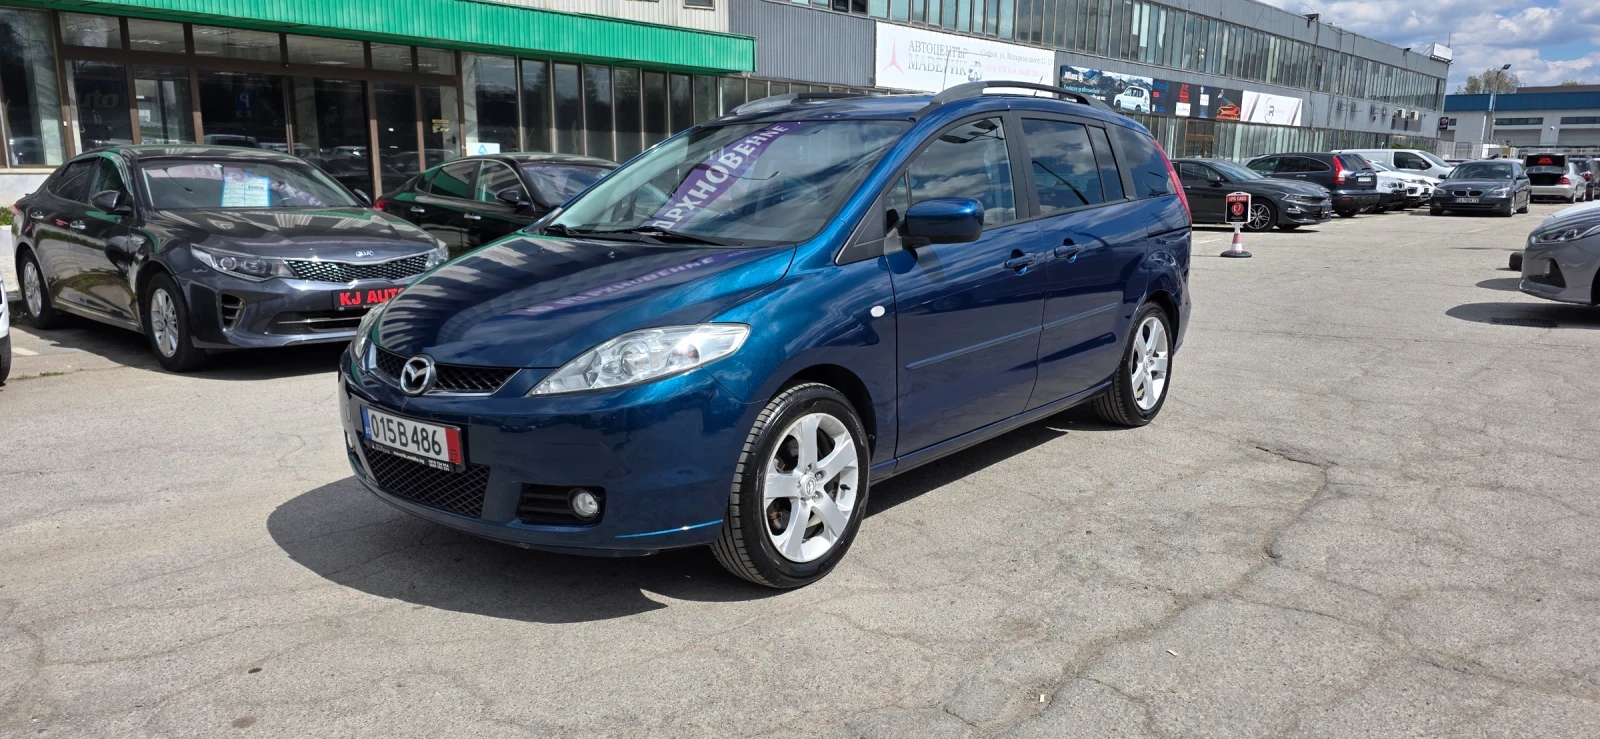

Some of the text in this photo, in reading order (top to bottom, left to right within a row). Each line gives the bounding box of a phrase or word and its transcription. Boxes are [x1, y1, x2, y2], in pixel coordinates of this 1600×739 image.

[908, 40, 968, 59] АВТОЦЕНТЪР
[908, 53, 967, 76] МАВЕРИК
[340, 291, 361, 306] KJ
